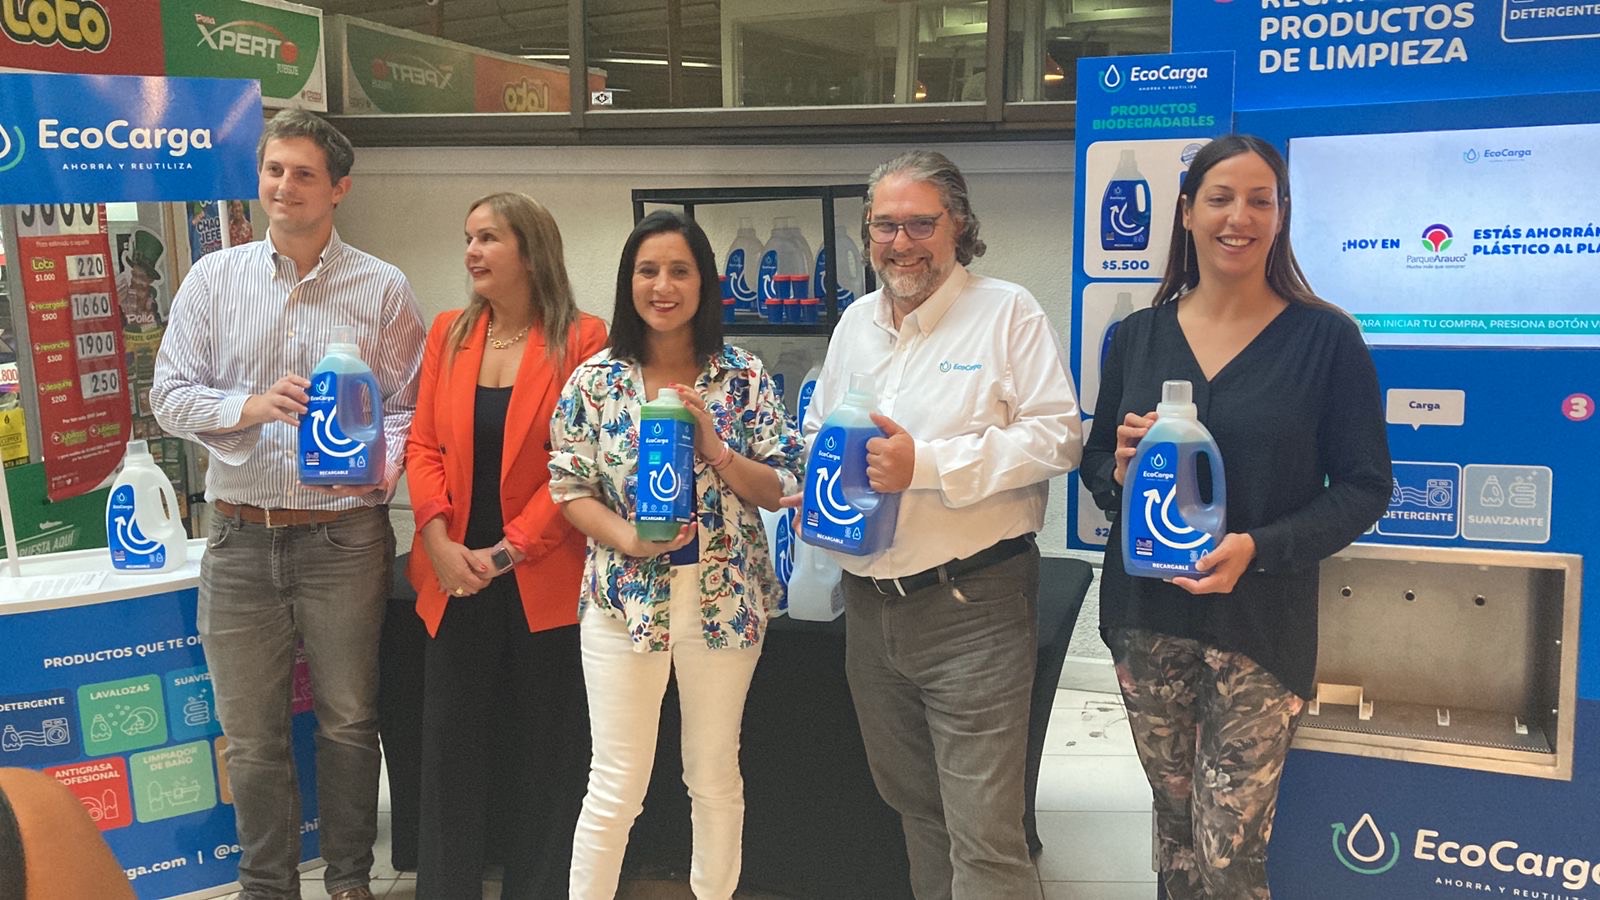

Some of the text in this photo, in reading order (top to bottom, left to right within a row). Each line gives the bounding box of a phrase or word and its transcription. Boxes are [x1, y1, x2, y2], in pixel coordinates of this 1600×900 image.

[1510, 4, 1600, 20] DETERGENTE
[1260, 2, 1475, 42] PRODUCTOS
[1259, 37, 1468, 74] DE LIMPIEZA
[1130, 65, 1208, 83] EcoCarga
[1110, 103, 1197, 116] PRODUCTOS
[1092, 116, 1215, 130] BIODEGRADABLES
[38, 118, 213, 157] EcoCarga
[1484, 148, 1532, 158] EcoCarga
[131, 162, 193, 170] REUTILIZA
[201, 229, 222, 243] JEFE
[1473, 224, 1523, 240] ESTÁS
[1342, 238, 1400, 252] ¡HOY EN
[1472, 241, 1550, 255] PLÁSTICO
[1554, 243, 1573, 254] AL
[77, 256, 103, 277] 220
[1102, 259, 1150, 272] $5.500
[74, 296, 109, 316] 1660
[1383, 319, 1420, 328] INICIAR
[1423, 319, 1437, 328] TU
[1439, 319, 1488, 330] COMPRA,
[1490, 319, 1545, 328] PRESIONA
[1548, 317, 1588, 328] BOTÓN
[79, 335, 113, 356] 1900
[91, 372, 118, 393] 250
[1409, 400, 1441, 411] Carga
[1569, 397, 1588, 418] 3
[1143, 470, 1174, 480] EcoCarga
[1467, 514, 1544, 527] SUAVIZANTE
[1095, 527, 1110, 537] $2
[18, 538, 51, 557] PUESTA
[43, 647, 133, 669] PRODUCTOS
[136, 641, 165, 657] QUE
[167, 638, 184, 650] TE
[90, 683, 150, 700] LAVALOZAS
[143, 746, 198, 764] LIMPIADOR
[55, 762, 113, 778] ANTIGRASA
[150, 763, 164, 772] DE
[62, 770, 120, 786] OFESIONAL
[124, 857, 187, 880] ga.com
[1435, 877, 1492, 892] AHORRA
[1499, 886, 1506, 894] Y
